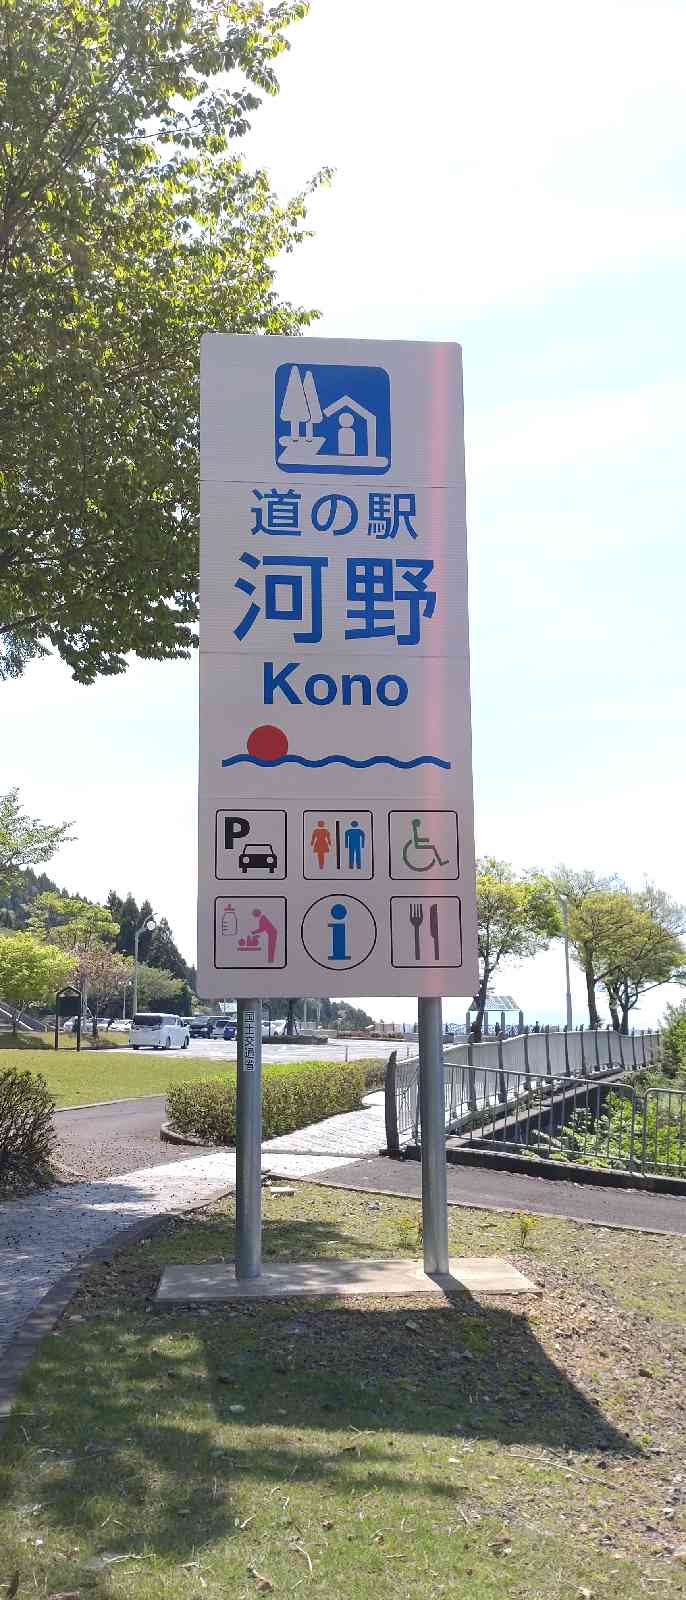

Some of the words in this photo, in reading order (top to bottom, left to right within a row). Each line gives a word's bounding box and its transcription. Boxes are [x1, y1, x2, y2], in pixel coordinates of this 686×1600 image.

[251, 489, 417, 540] 道の駅
[234, 553, 437, 646] 河野
[264, 662, 409, 706] Kono
[225, 817, 250, 850] P
[243, 1010, 256, 1072] 国土交通省
